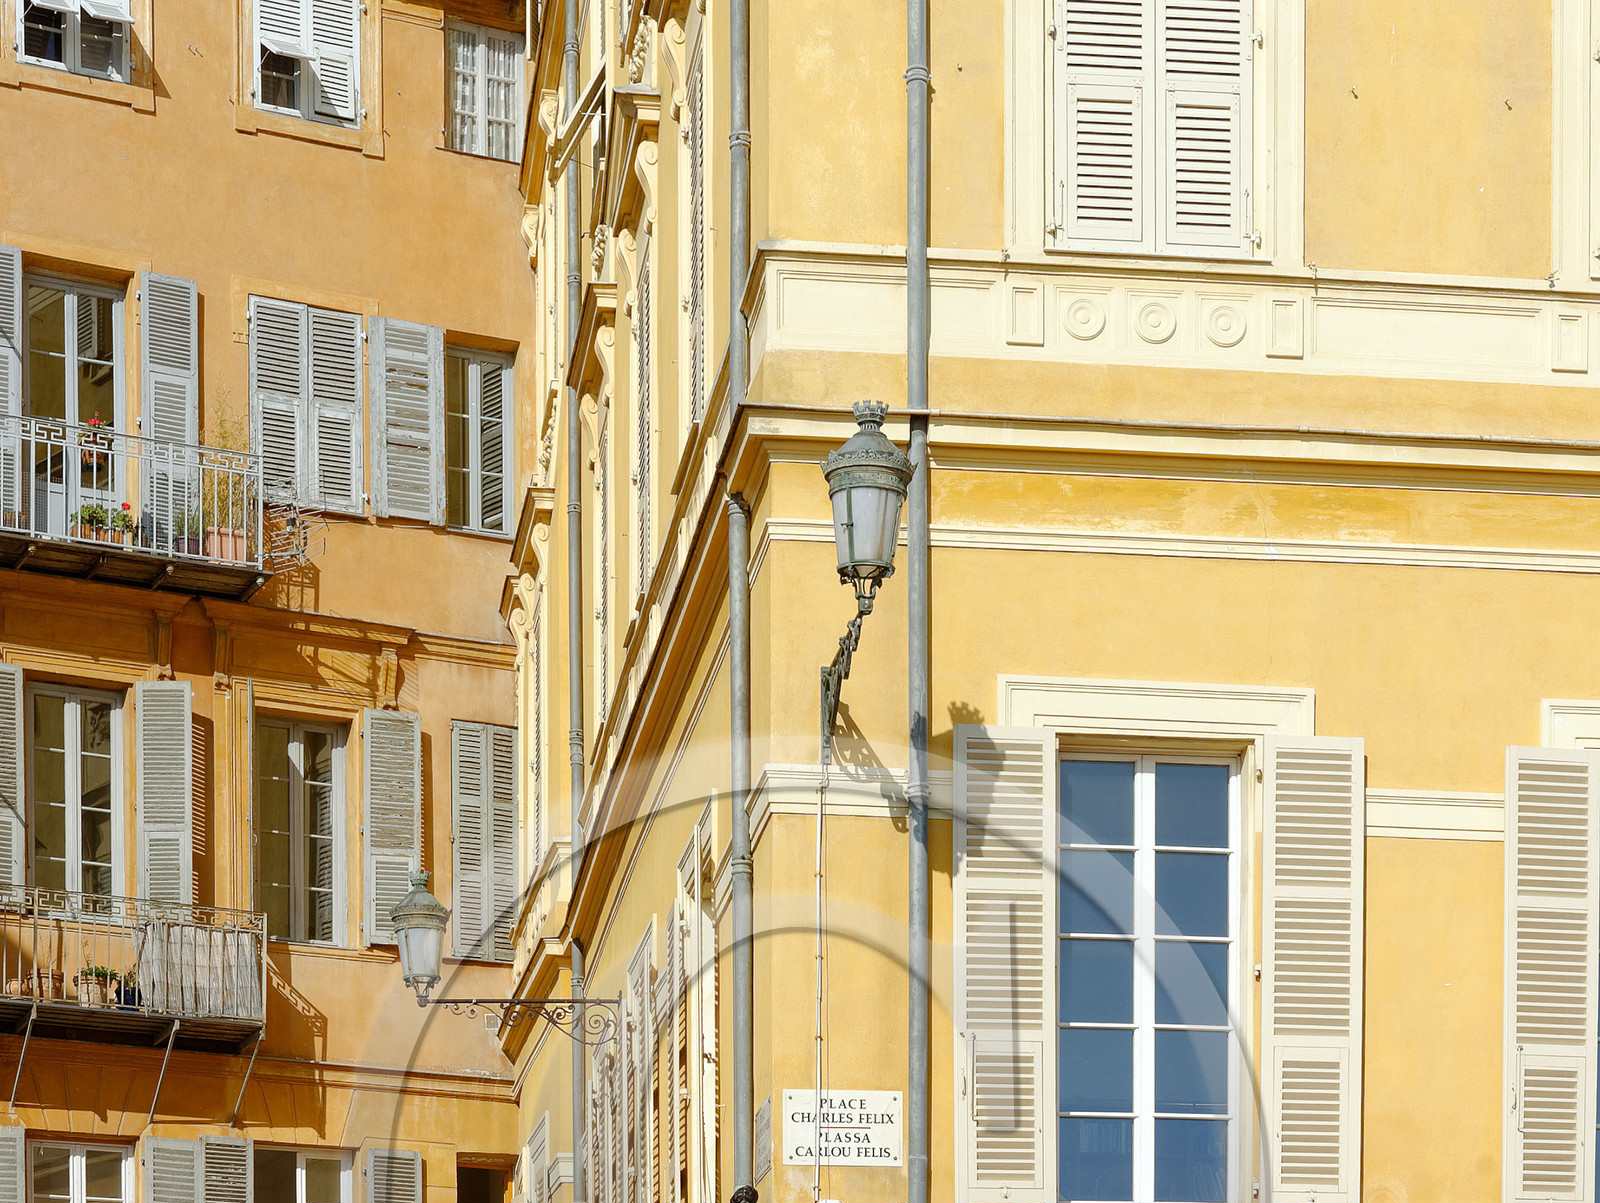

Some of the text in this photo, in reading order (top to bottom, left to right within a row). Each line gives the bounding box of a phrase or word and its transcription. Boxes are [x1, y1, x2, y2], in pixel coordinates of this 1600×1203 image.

[820, 1098, 867, 1110] PLACE
[859, 1113, 895, 1124] FELIX
[857, 1147, 891, 1159] FELIS
